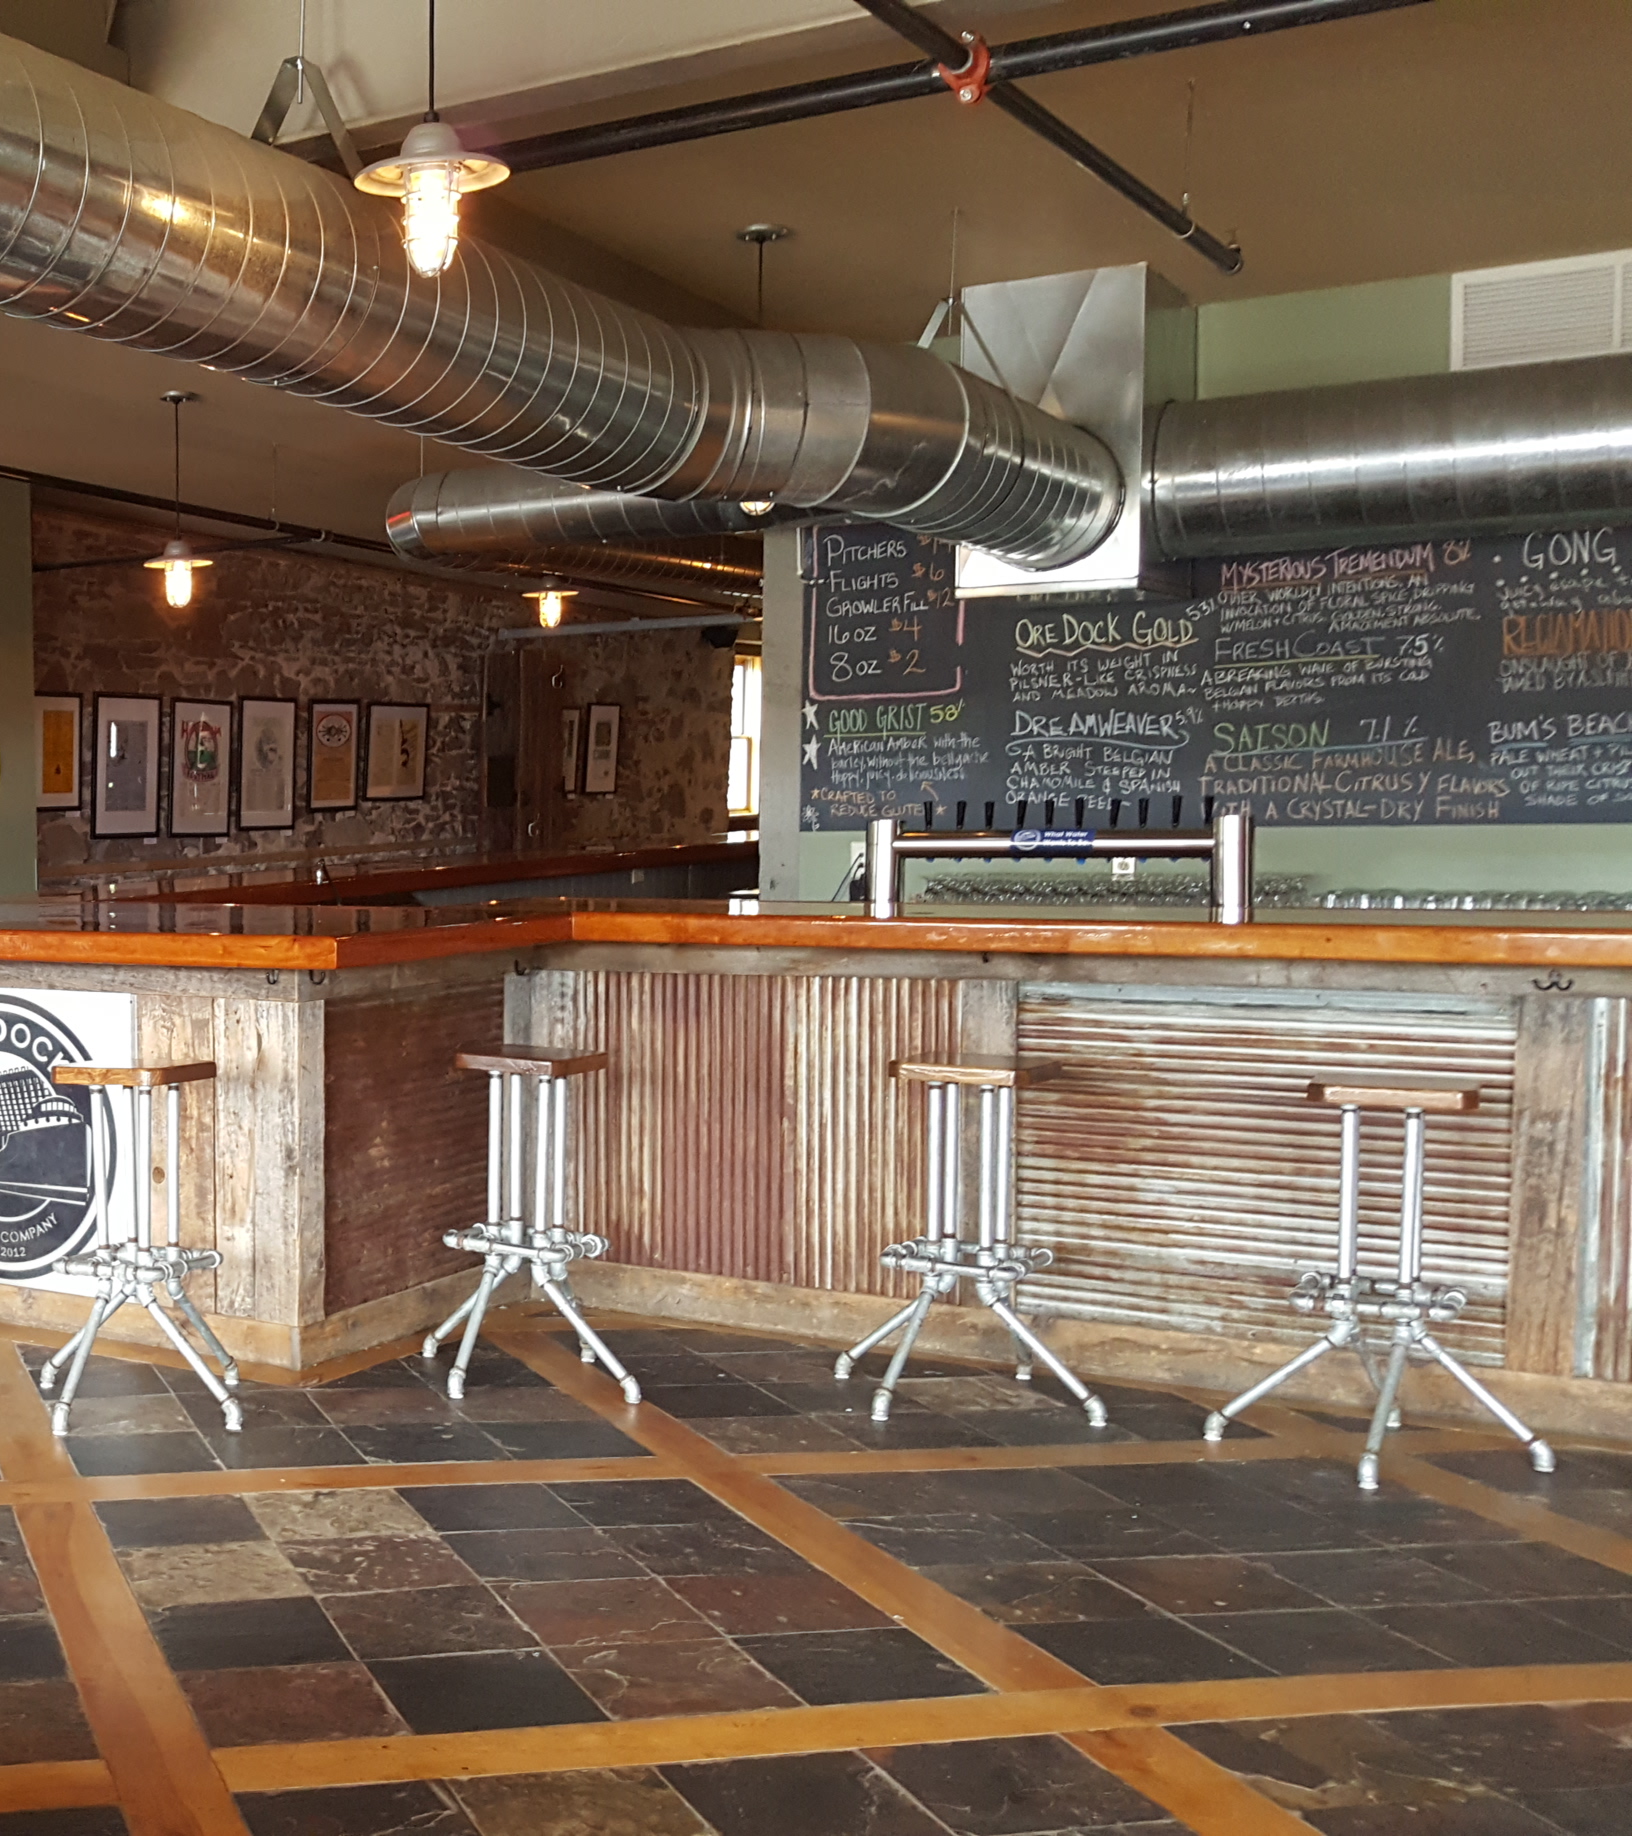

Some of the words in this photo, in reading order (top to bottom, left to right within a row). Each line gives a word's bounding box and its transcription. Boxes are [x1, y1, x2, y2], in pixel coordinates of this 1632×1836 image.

[823, 534, 908, 566] PITCHERS
[1522, 527, 1617, 570] GONG
[829, 570, 899, 593] FLIGHTS
[911, 562, 945, 581] $6
[1221, 556, 1327, 594] MYSTERIOUS
[1325, 542, 1435, 579] TREMENDUM
[826, 597, 901, 617] GROWLER
[903, 591, 929, 612] FILL
[888, 615, 923, 642] $4
[1016, 618, 1059, 647] ORE
[1062, 612, 1122, 646] DOCK
[1132, 610, 1194, 646] GOLD
[1214, 637, 1290, 663] FRESH
[1292, 629, 1386, 656] COAST
[830, 652, 853, 682] 8
[888, 649, 927, 676] $2
[1010, 660, 1055, 676] WORTH
[1068, 657, 1089, 673] ITS
[1097, 653, 1152, 672] WEIGHT
[1162, 650, 1179, 663] IN
[1343, 660, 1359, 673] OF
[1330, 673, 1366, 688] FROM
[1370, 672, 1392, 685] ITS
[1012, 690, 1041, 703] AND
[1051, 687, 1119, 700] MEADOW
[828, 708, 867, 745] GOOD
[876, 702, 928, 741] GRIST
[1010, 708, 1180, 740] DREAMWEAVER
[1213, 718, 1330, 755] SAISON
[1487, 713, 1558, 744] BUM'S
[1021, 744, 1036, 761] A
[1043, 743, 1094, 760] BRIGHT
[1103, 748, 1174, 767] BELGIAN
[1203, 753, 1217, 773] A
[1222, 753, 1303, 773] CLASSIC
[1311, 741, 1424, 770] FARMHOUSE
[1010, 761, 1072, 776] AMBER
[1151, 767, 1172, 781] IN
[1197, 770, 1332, 797] TRADITIONAL
[1335, 769, 1432, 793] CITRUSY
[1437, 773, 1512, 798] FLAVORS
[821, 788, 875, 804] CRAFTED
[880, 789, 897, 801] TO
[1118, 779, 1181, 795] SPANISH
[830, 803, 878, 818] REDUCE
[880, 803, 926, 817] GLUTE
[1265, 801, 1278, 820] A
[1435, 795, 1501, 819] FINISH
[0, 1211, 59, 1244] COMPANY
[0, 1246, 27, 1258] 2012
